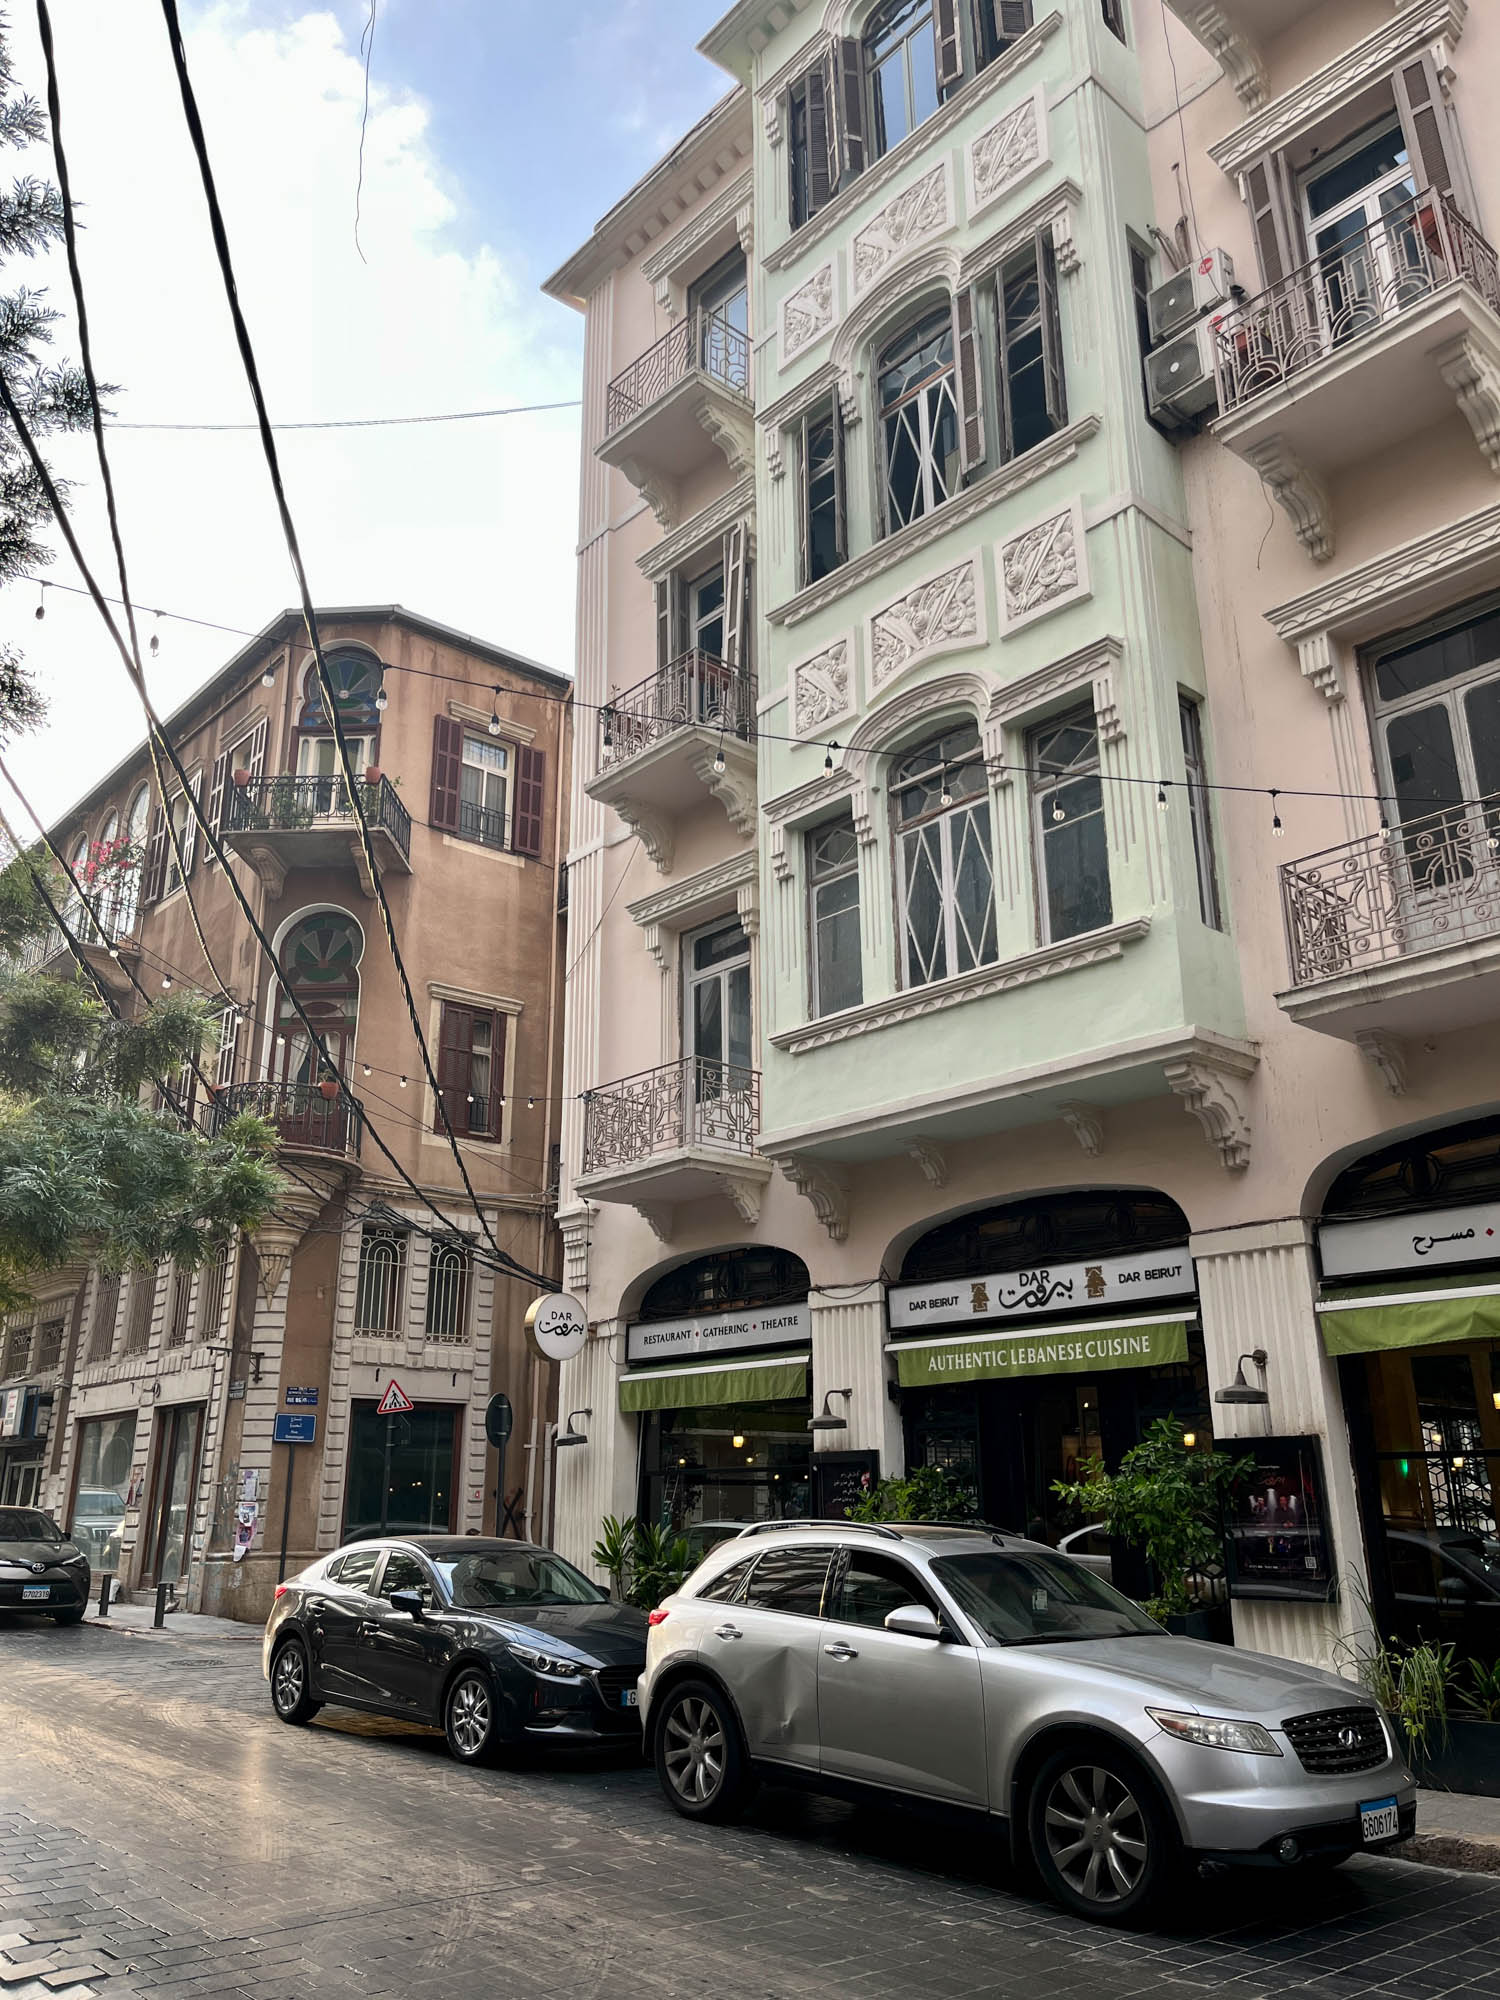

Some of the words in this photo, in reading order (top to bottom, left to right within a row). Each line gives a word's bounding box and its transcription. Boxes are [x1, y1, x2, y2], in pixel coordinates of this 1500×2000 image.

[1412, 1228, 1475, 1255] مسرح
[1019, 1270, 1050, 1287] DAR
[1118, 1271, 1141, 1284] DAR
[1144, 1265, 1182, 1280] BEIRUT
[909, 1301, 927, 1312] DAR
[929, 1296, 959, 1309] BEIRUT
[999, 1278, 1073, 1308] بيروت
[551, 1311, 572, 1321] DAR
[539, 1321, 584, 1336] بيروت
[643, 1329, 691, 1345] RESTAURANT
[703, 1323, 749, 1338] GATHERING
[761, 1315, 798, 1330] THEATRE
[928, 1350, 1008, 1372] AUTHENTIC
[1010, 1341, 1083, 1365] LEBANESE
[1085, 1336, 1151, 1358] CUISINE
[1363, 1810, 1398, 1838] G606174
